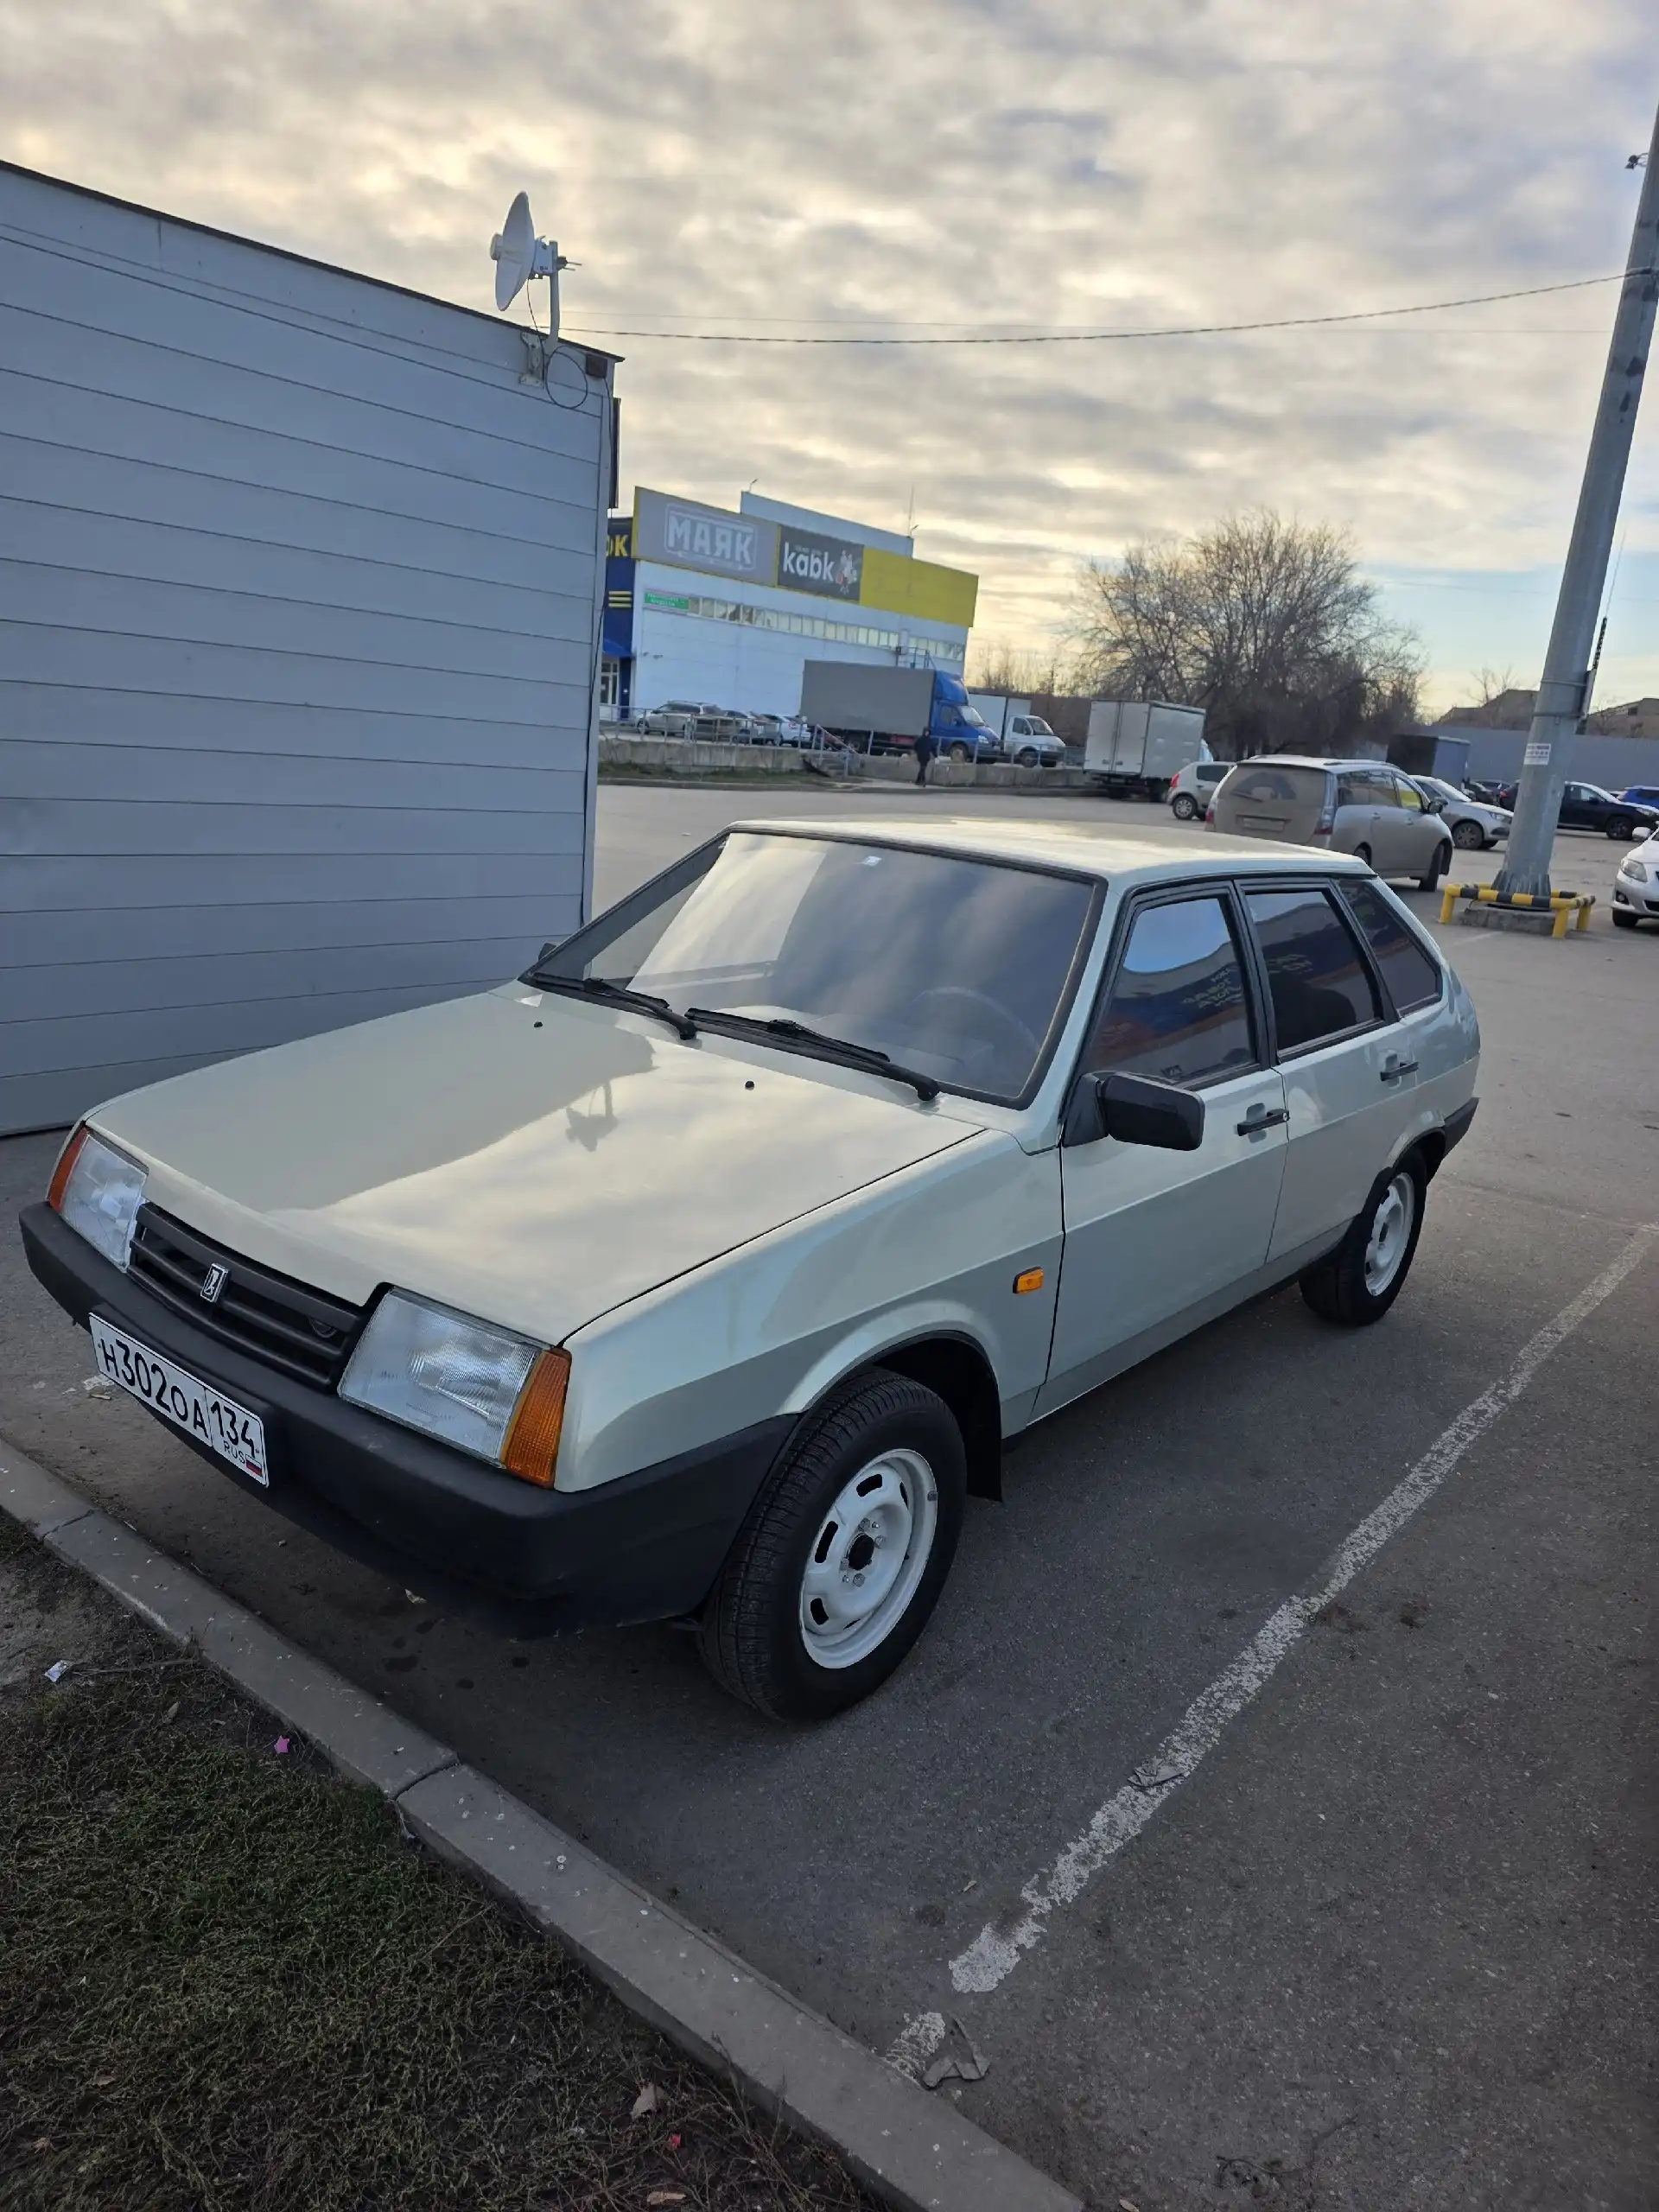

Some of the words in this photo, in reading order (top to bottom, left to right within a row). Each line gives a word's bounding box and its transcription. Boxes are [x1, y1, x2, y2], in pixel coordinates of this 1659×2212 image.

[668, 514, 753, 565] МАЯК
[210, 1401, 256, 1459] 134
[223, 1440, 246, 1464] RUS
